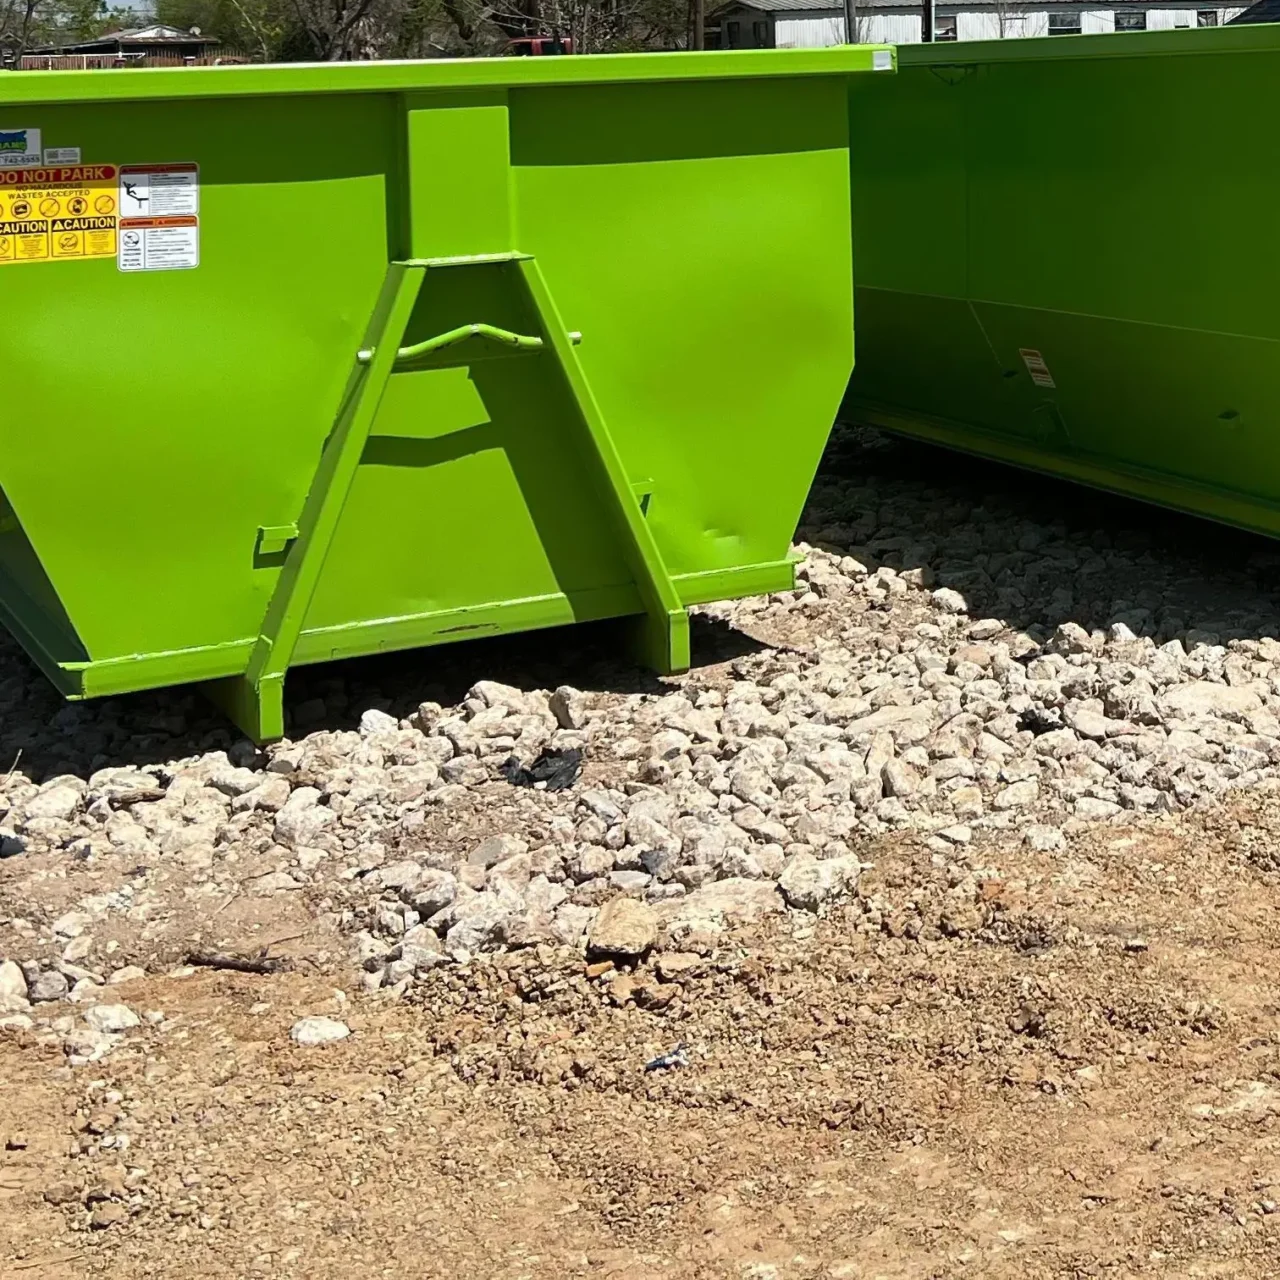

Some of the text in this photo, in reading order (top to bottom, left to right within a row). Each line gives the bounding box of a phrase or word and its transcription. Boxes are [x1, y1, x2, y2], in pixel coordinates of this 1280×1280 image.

[23, 170, 57, 183] NOT
[61, 167, 106, 181] PARK
[8, 190, 90, 200] WASTES ACCEPTED
[0, 221, 47, 234] AUTION
[64, 217, 115, 230] CAUTION
